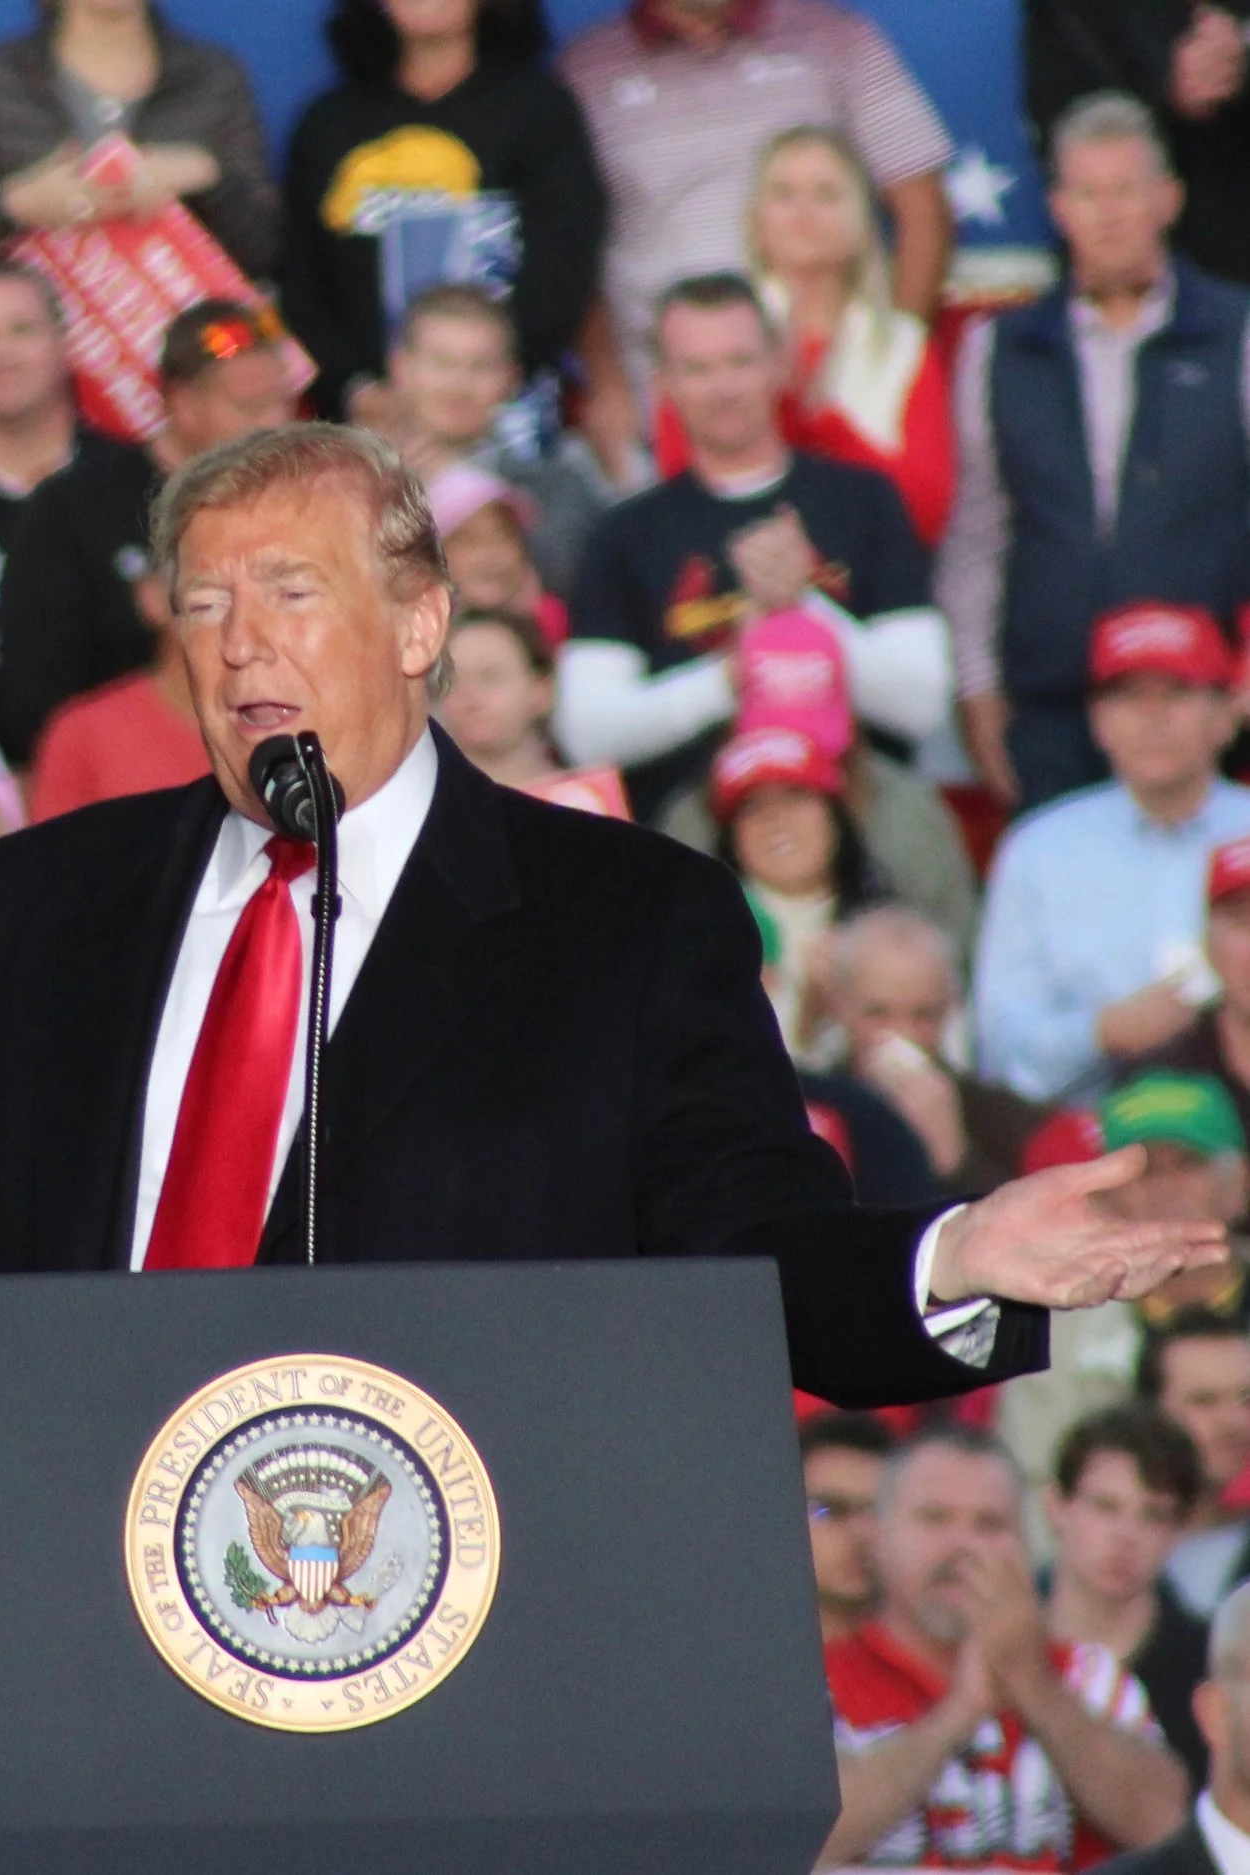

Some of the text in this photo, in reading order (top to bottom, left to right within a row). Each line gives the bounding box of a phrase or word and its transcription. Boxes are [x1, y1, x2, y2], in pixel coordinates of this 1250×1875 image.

[139, 1368, 487, 1713] SEAL OF THE PRESIDENT OF THE UNITED STATES
